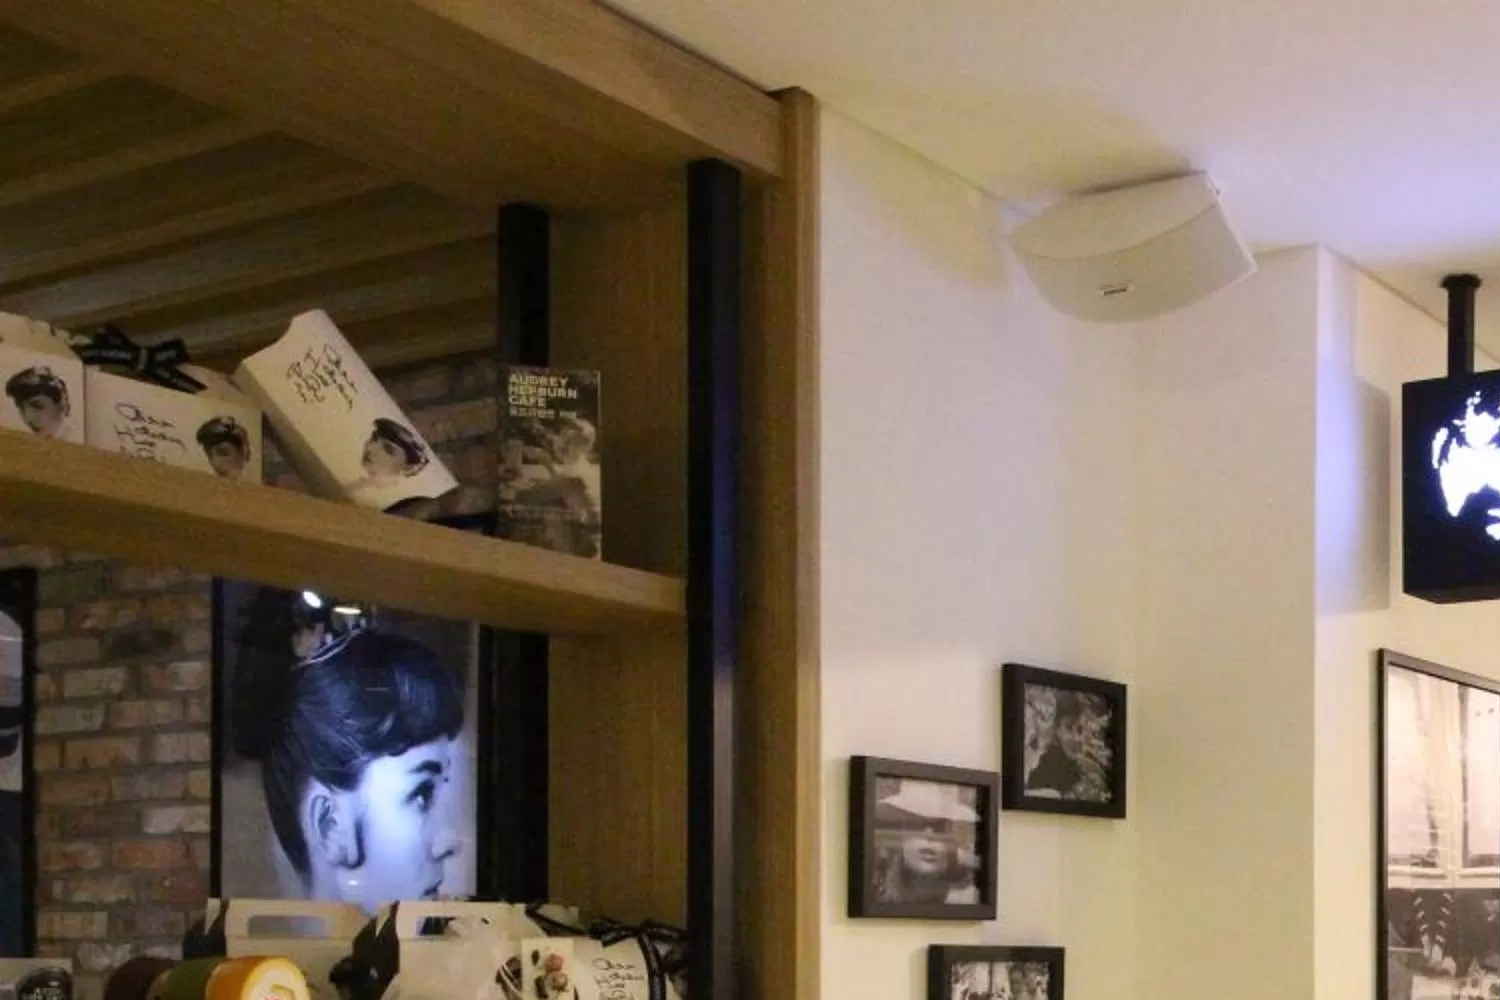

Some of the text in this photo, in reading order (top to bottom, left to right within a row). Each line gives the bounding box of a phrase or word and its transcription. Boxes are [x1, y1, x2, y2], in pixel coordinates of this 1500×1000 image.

[508, 374, 569, 388] AUDREY
[508, 384, 577, 399] HEPBURN
[508, 395, 547, 408] CAFE
